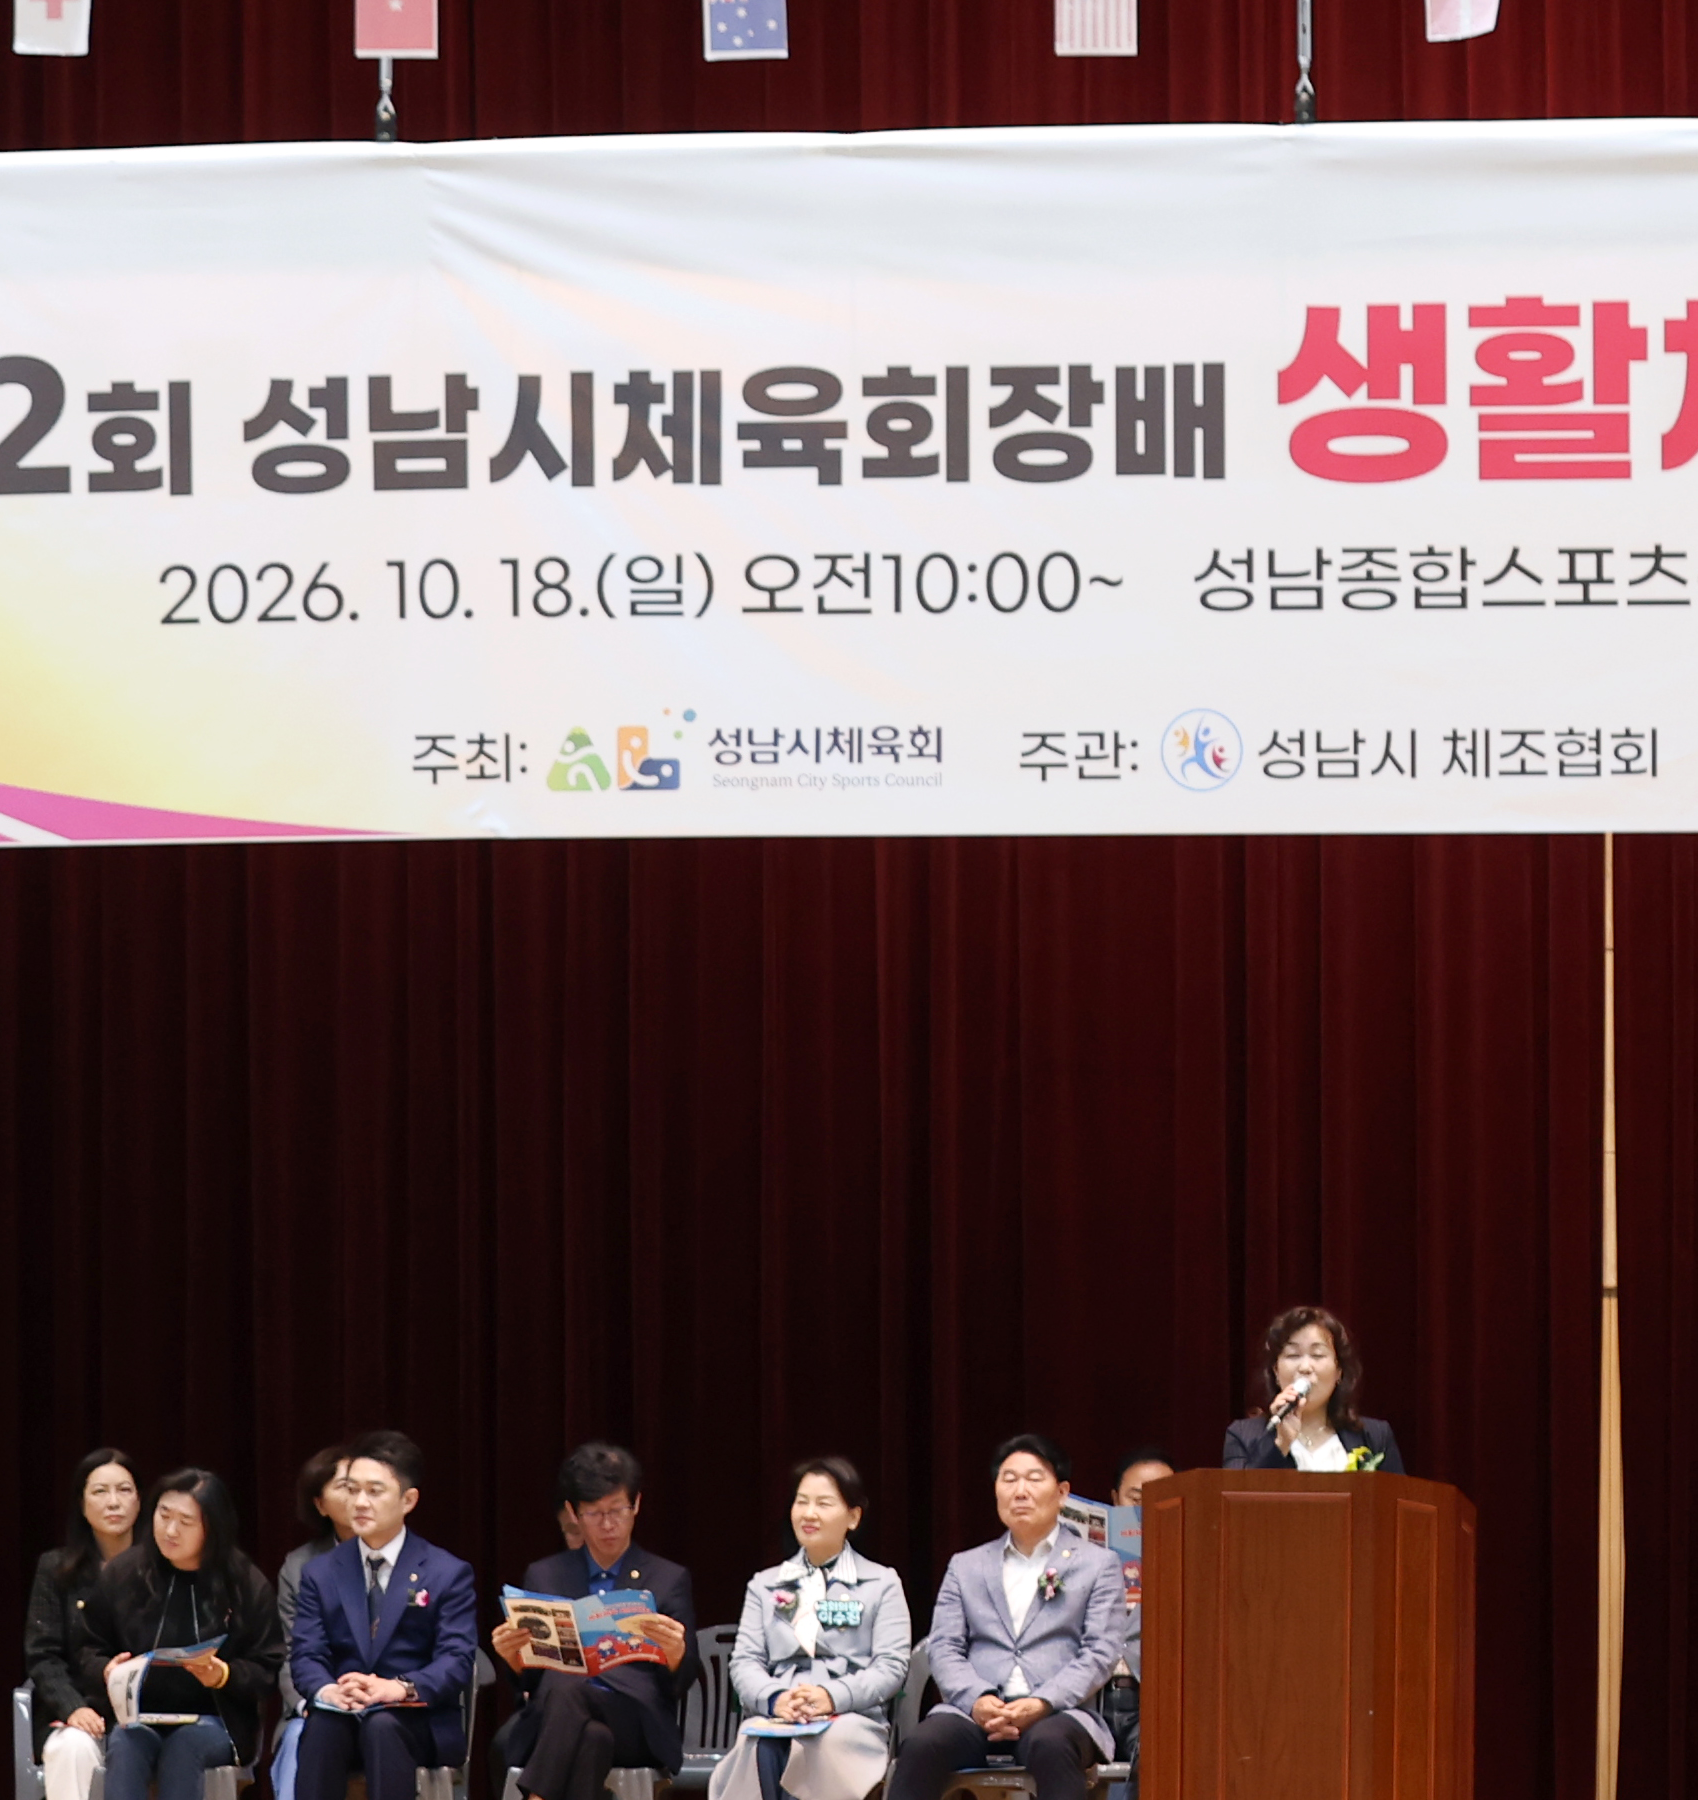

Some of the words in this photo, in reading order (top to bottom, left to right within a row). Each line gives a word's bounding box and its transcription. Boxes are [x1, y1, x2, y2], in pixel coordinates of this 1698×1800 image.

[242, 362, 1227, 496] 성남시체육회장배
[159, 562, 360, 625] 2026.
[386, 558, 475, 620] 10.
[500, 552, 715, 619] 18.(일)
[741, 551, 1124, 615] 오전10:00~
[411, 731, 529, 785] 주최:
[708, 725, 944, 766] 성남시체육회
[1018, 730, 1140, 783] 주관:
[1257, 728, 1418, 780] 성남시
[1441, 727, 1659, 779] 체조협회
[712, 773, 793, 791] Seongnam
[797, 772, 828, 791] City
[832, 772, 881, 791] Sports
[884, 771, 944, 788] Council
